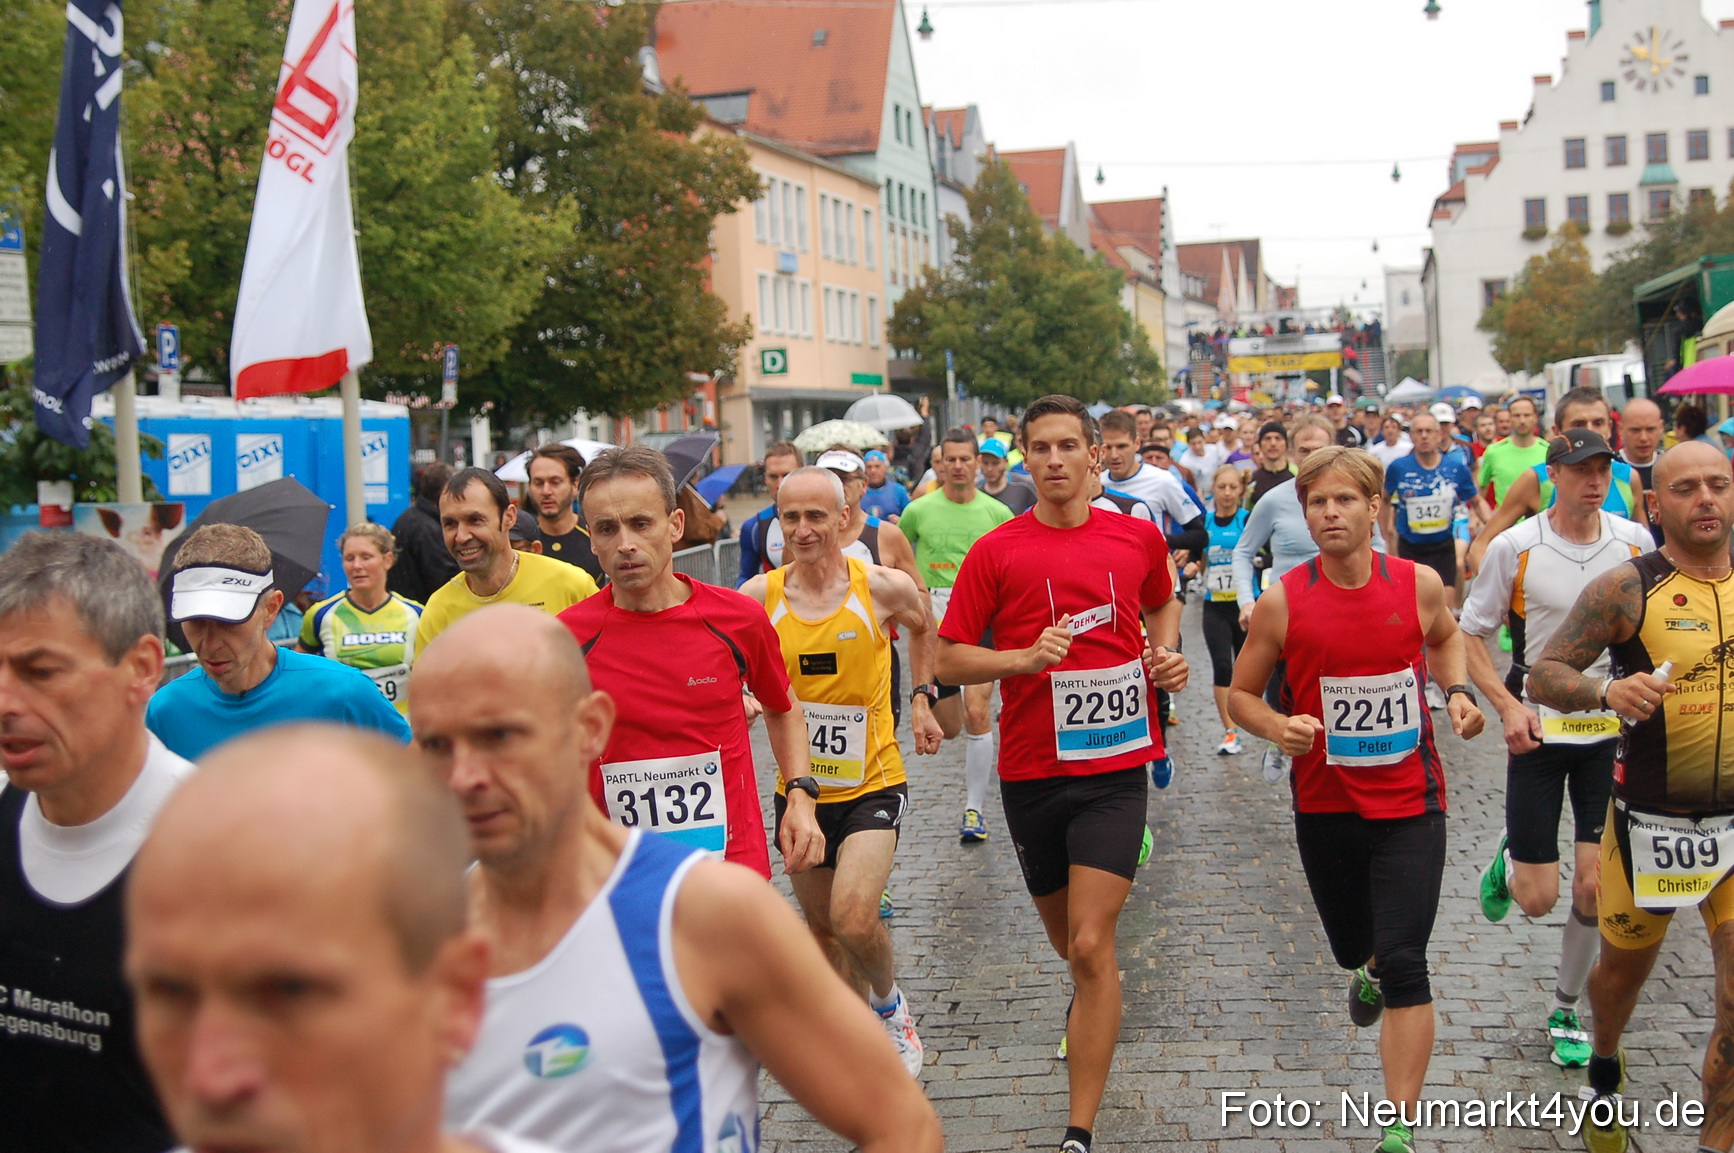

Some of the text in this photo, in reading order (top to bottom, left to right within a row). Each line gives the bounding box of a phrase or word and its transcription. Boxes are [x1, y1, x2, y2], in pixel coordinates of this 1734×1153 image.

[763, 350, 785, 373] D
[1416, 505, 1440, 519] 342
[222, 577, 252, 587] 2XU
[1074, 613, 1097, 630] DEHN
[343, 631, 406, 646] BOCK
[1055, 672, 1131, 689] PARTL Neumarkt
[1323, 681, 1403, 695] PARTL Neumarkt
[1064, 684, 1140, 726] 2293
[1332, 692, 1410, 732] 2241
[809, 711, 851, 722] Neumarkt
[1561, 721, 1607, 734] Andreas
[807, 724, 848, 756] 45
[1085, 729, 1127, 747] Jürgen
[1358, 740, 1393, 753] Peter
[606, 767, 700, 785] PARTL Neumarkt
[810, 762, 840, 776] erner
[616, 781, 715, 827] 3132
[1652, 835, 1720, 870] 509
[13, 988, 111, 1027] Marathon
